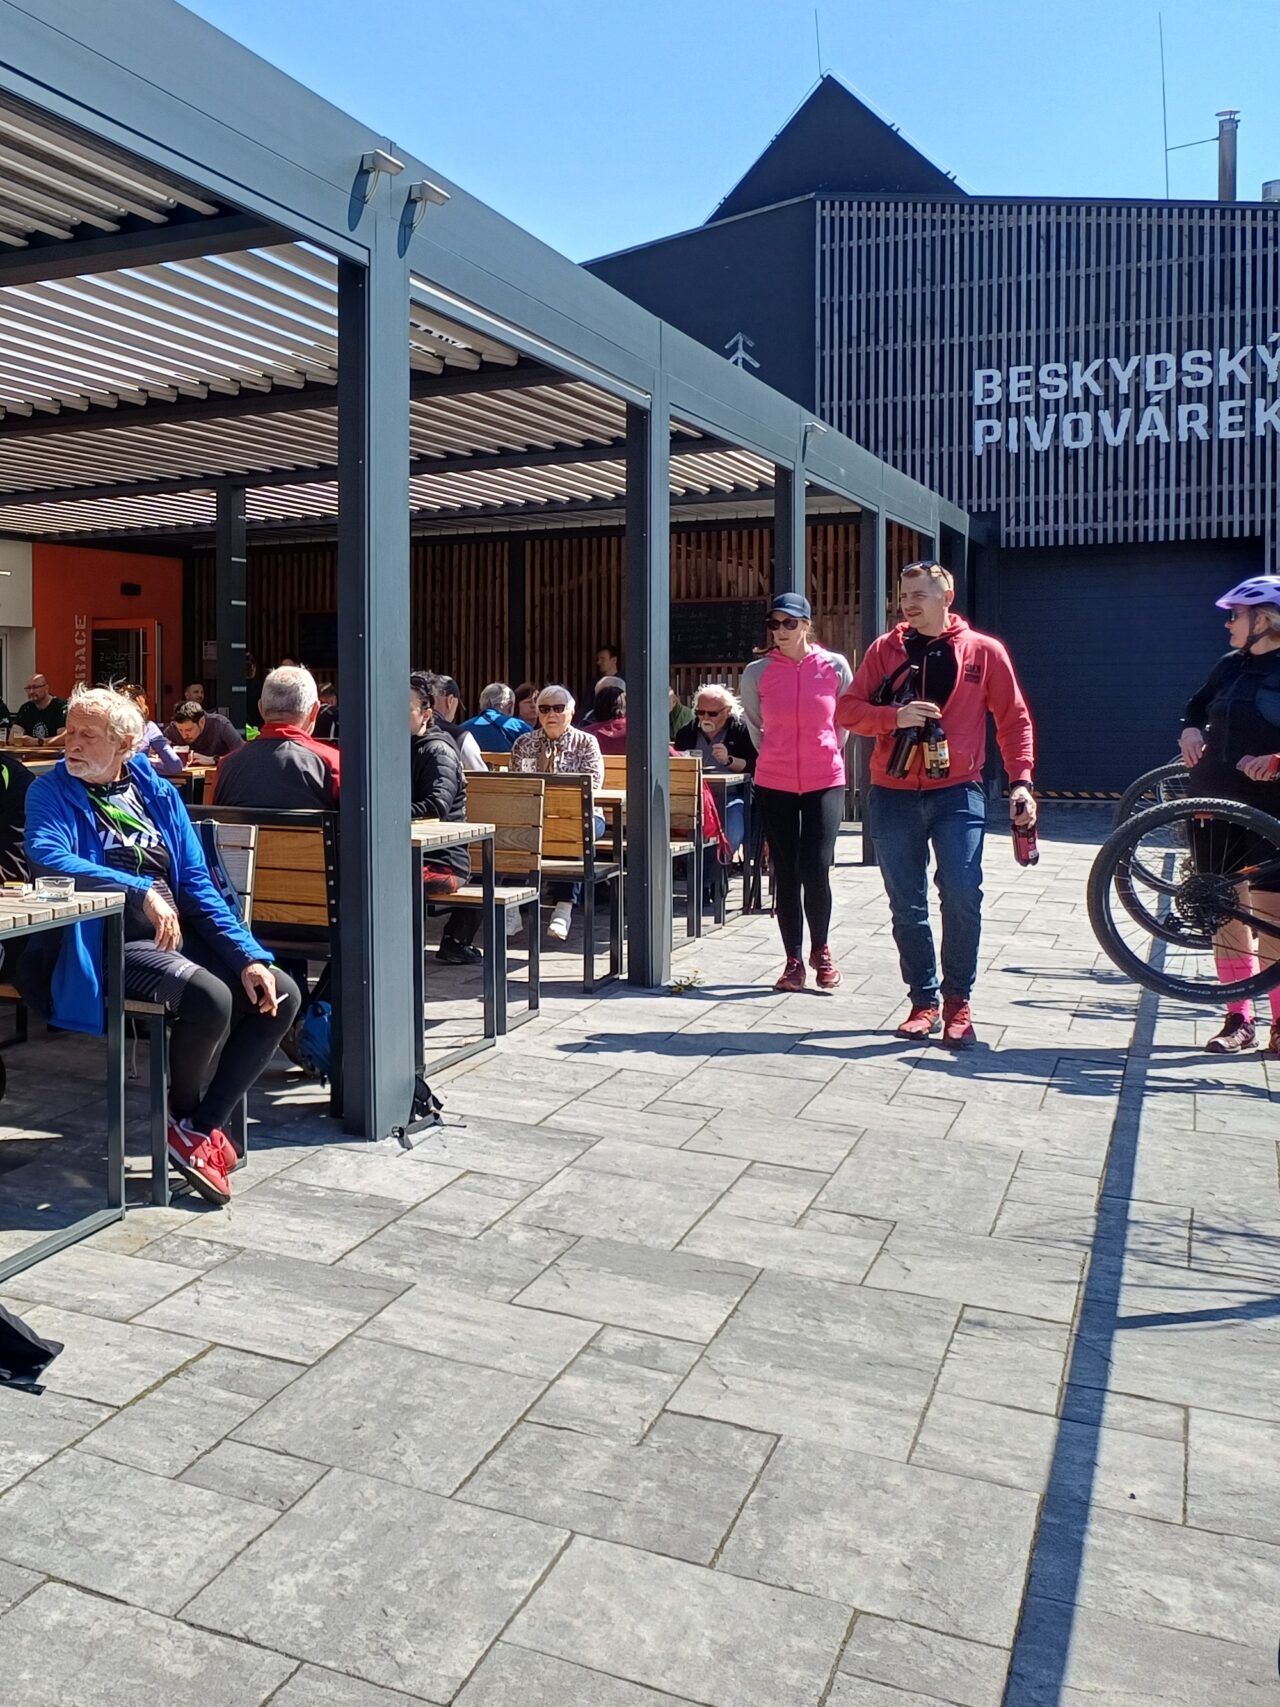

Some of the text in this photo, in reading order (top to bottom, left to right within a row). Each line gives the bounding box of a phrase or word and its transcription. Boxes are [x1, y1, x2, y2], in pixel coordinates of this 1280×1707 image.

[974, 332, 1280, 406] BESKYDSKÝ
[974, 394, 1280, 456] PIVOVÁREK
[74, 614, 87, 682] RACE
